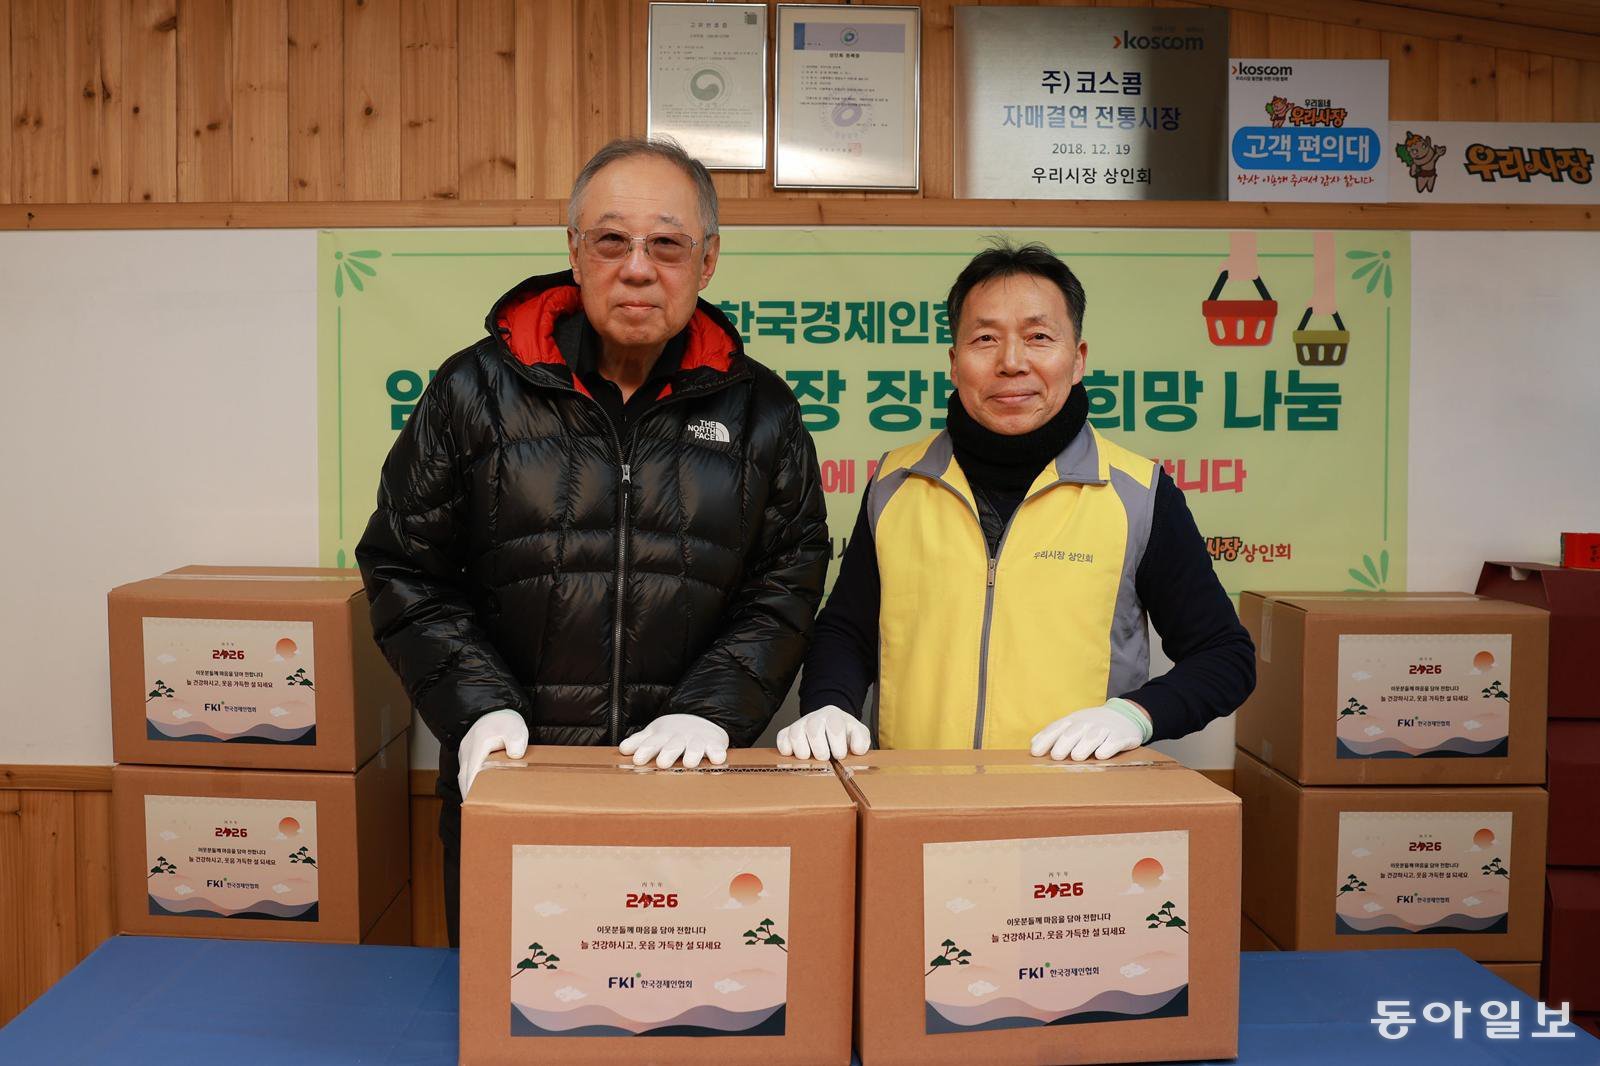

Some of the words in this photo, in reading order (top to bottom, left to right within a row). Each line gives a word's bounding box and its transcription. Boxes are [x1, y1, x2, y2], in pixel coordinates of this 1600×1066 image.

[1124, 30, 1204, 50] koscom
[1239, 62, 1292, 76] koscom
[1041, 70, 1070, 95] 주)
[1076, 71, 1142, 95] 코스콤
[1305, 99, 1331, 108] 우리동네
[1002, 105, 1088, 129] 자매결연
[1095, 106, 1181, 131] 전통시장
[1289, 106, 1347, 128] 우리시장
[1052, 143, 1086, 155] 2018.
[1091, 143, 1110, 155] 12.
[1115, 144, 1130, 155] 19
[1243, 134, 1291, 163] 고객
[1297, 134, 1370, 163] 편의대
[1463, 143, 1594, 185] 우리시장
[1031, 167, 1097, 184] 우리시장
[1103, 168, 1151, 185] 상인회
[1320, 175, 1340, 187] 감사
[773, 369, 847, 432] 장
[1082, 369, 1204, 432] 희망
[1223, 369, 1342, 431] 나눔
[687, 424, 715, 434] NORTH
[700, 420, 715, 428] THE
[694, 431, 715, 441] FACE
[1155, 458, 1247, 493] 니다
[1033, 550, 1065, 561] 우리시장
[1068, 552, 1094, 563] 상인회
[1240, 543, 1291, 563] 상인회
[204, 703, 221, 712] FKI
[1397, 719, 1414, 727] FKI
[206, 879, 223, 888] FKI
[1396, 895, 1414, 903] FKI
[1006, 916, 1042, 926] 이웃분들께
[1044, 915, 1065, 925] 마음을
[1066, 914, 1081, 924] 담아
[1083, 912, 1111, 923] 전합니다
[596, 925, 635, 935] 이웃분들께
[635, 925, 658, 935] 마음을
[660, 925, 675, 935] 담아
[676, 925, 706, 935] 전합니다
[991, 933, 999, 944] 늘
[1047, 929, 1064, 940] 웃음
[1065, 928, 1090, 939] 가득한
[1092, 928, 1100, 938] 설
[1102, 926, 1126, 936] 되세요
[580, 940, 589, 950] 늘
[639, 940, 655, 950] 웃음
[658, 940, 683, 950] 가득한
[686, 940, 694, 950] 설
[696, 940, 722, 950] 되세요
[1018, 967, 1044, 980] FKI
[1050, 966, 1100, 977] 한국경제인협회
[608, 977, 635, 989] FKI
[641, 979, 693, 989] 한국경제인협회
